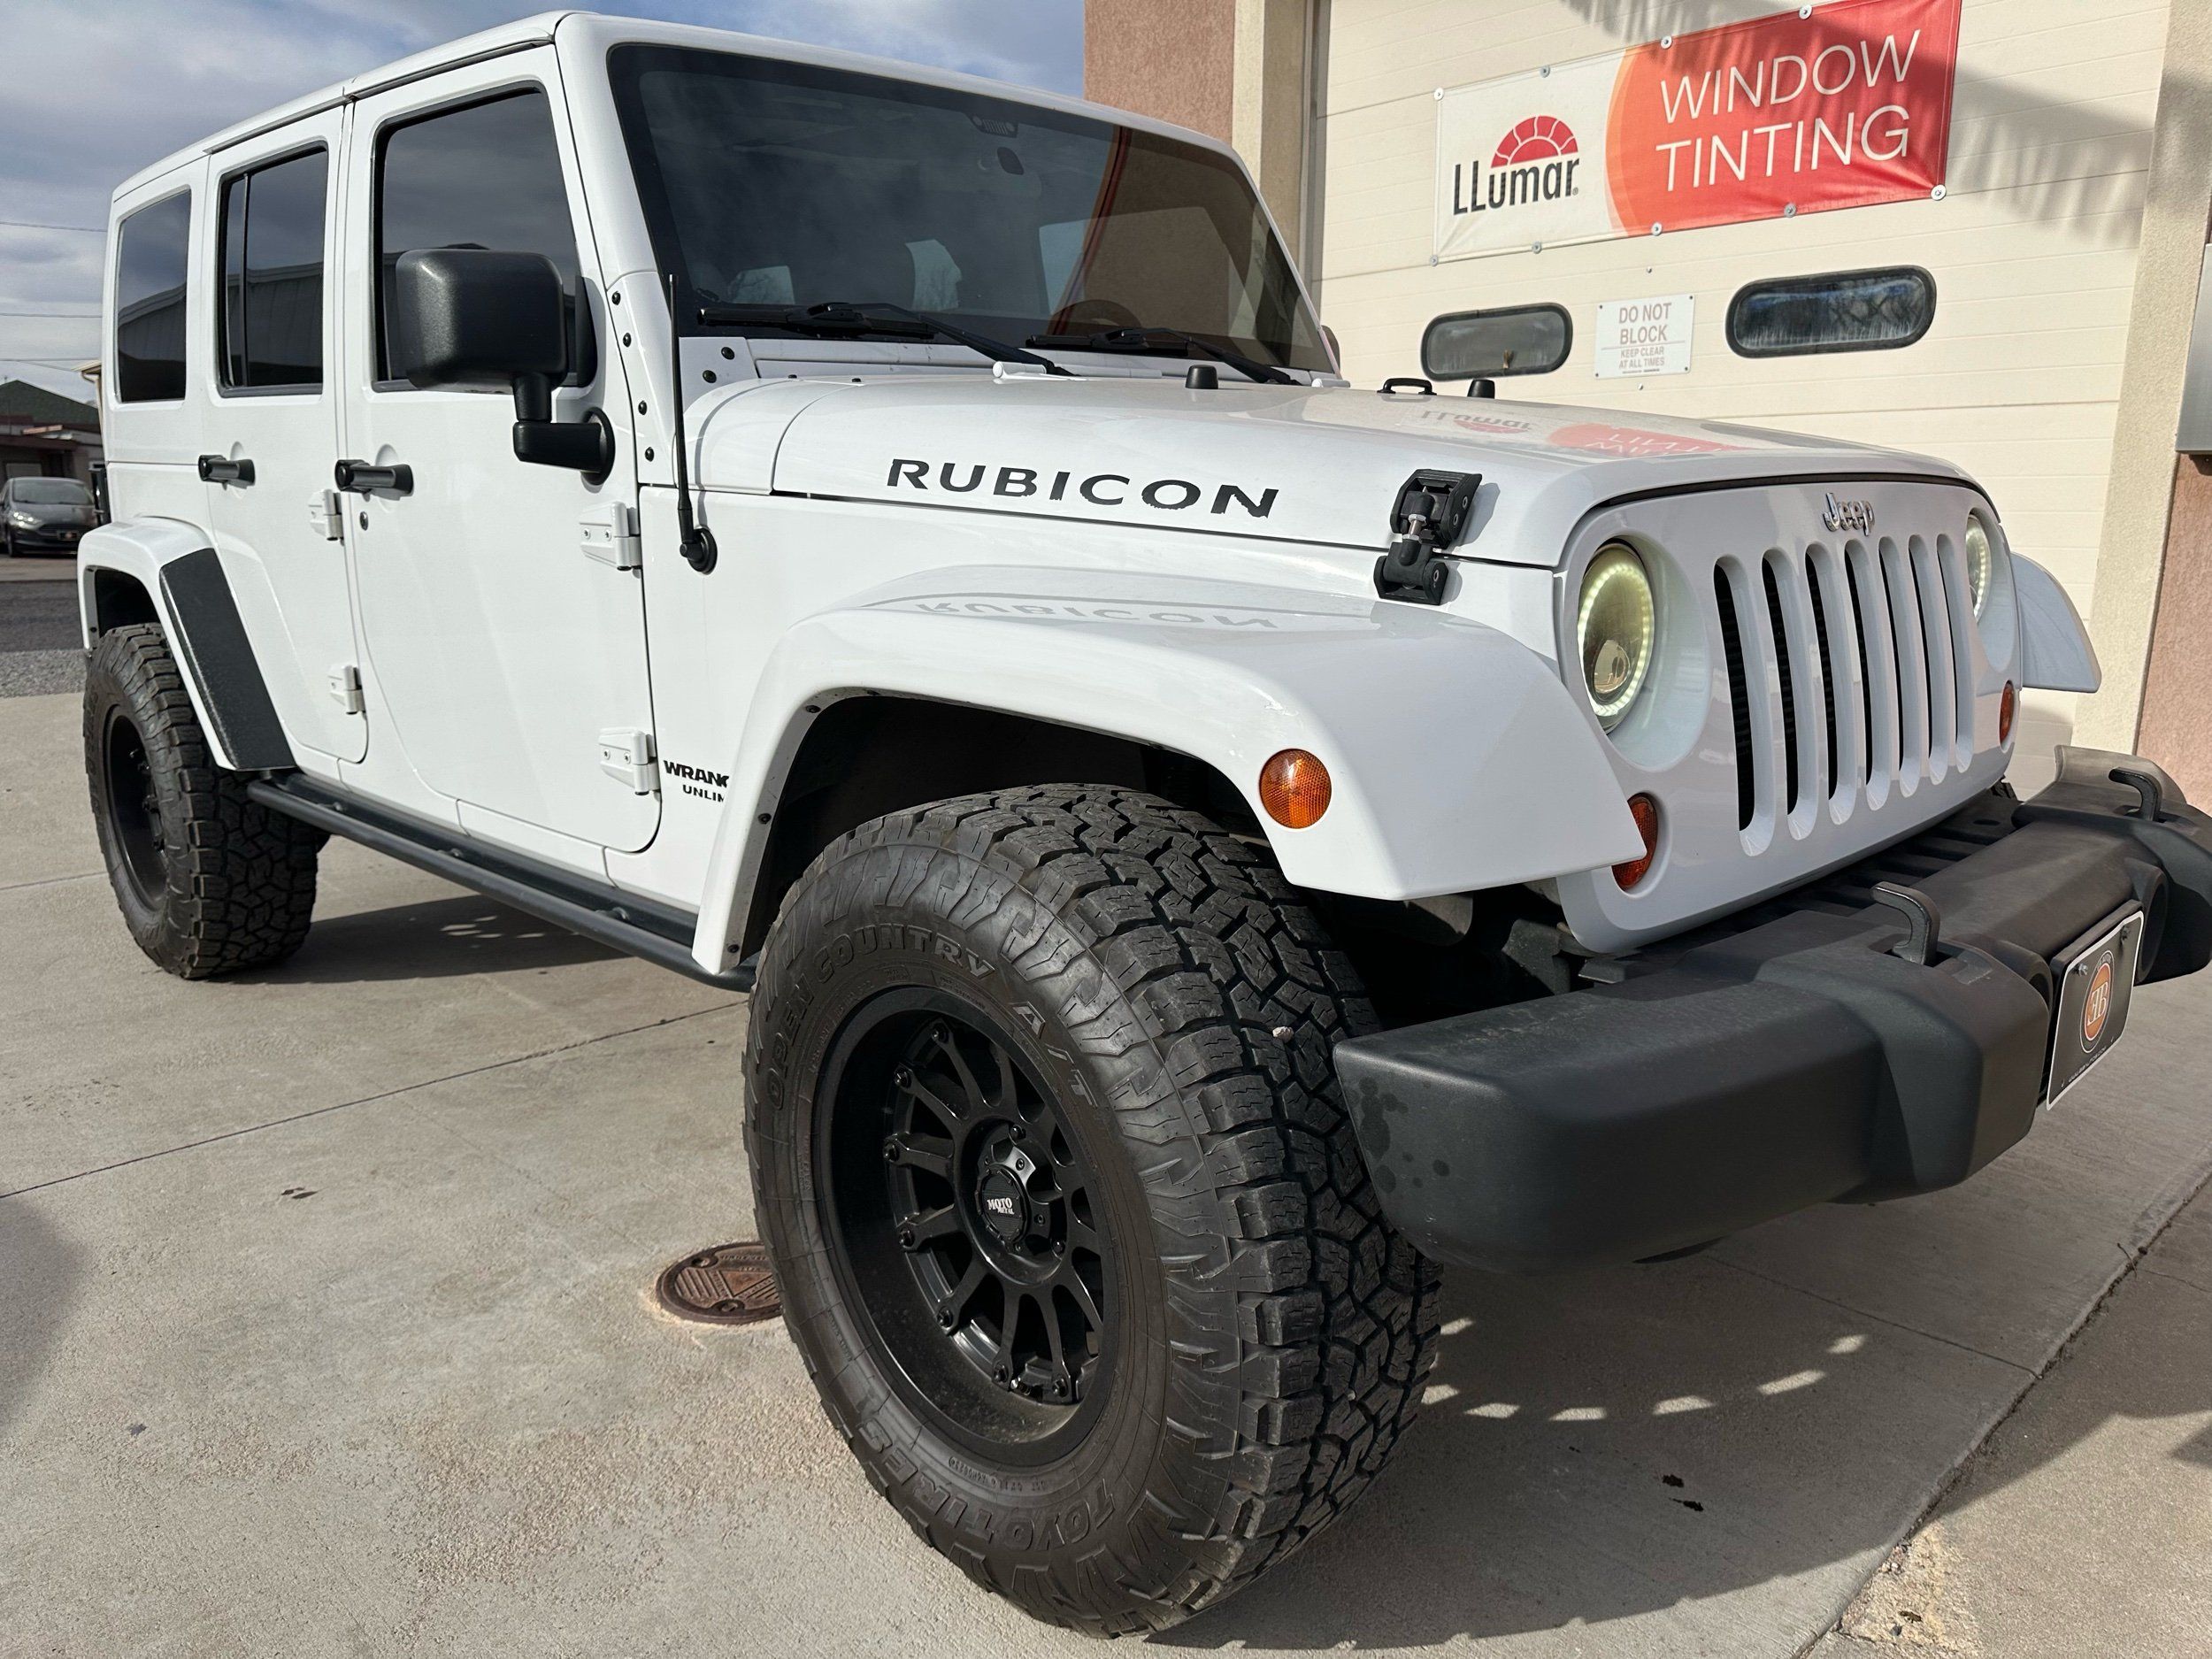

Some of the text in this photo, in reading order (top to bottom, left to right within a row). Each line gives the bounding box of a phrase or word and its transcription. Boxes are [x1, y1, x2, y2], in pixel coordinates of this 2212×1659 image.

[1661, 29, 1921, 124] WINDOW
[1656, 104, 1910, 192] TINTING
[1453, 157, 1580, 215] LLumar
[1619, 302, 1672, 324] DO NOT
[1619, 324, 1668, 345] BLOCK
[1619, 357, 1665, 369] AT ALL TIMES
[1620, 346, 1665, 358] KEEP CLEAR
[887, 458, 1279, 518] RUBICON
[1823, 492, 1875, 536] Jeep
[766, 972, 815, 1110] OPEN
[812, 923, 996, 984] COUNTRY
[987, 1197, 1013, 1210] MOTO
[856, 1417, 1115, 1552] TOYO TIRES
